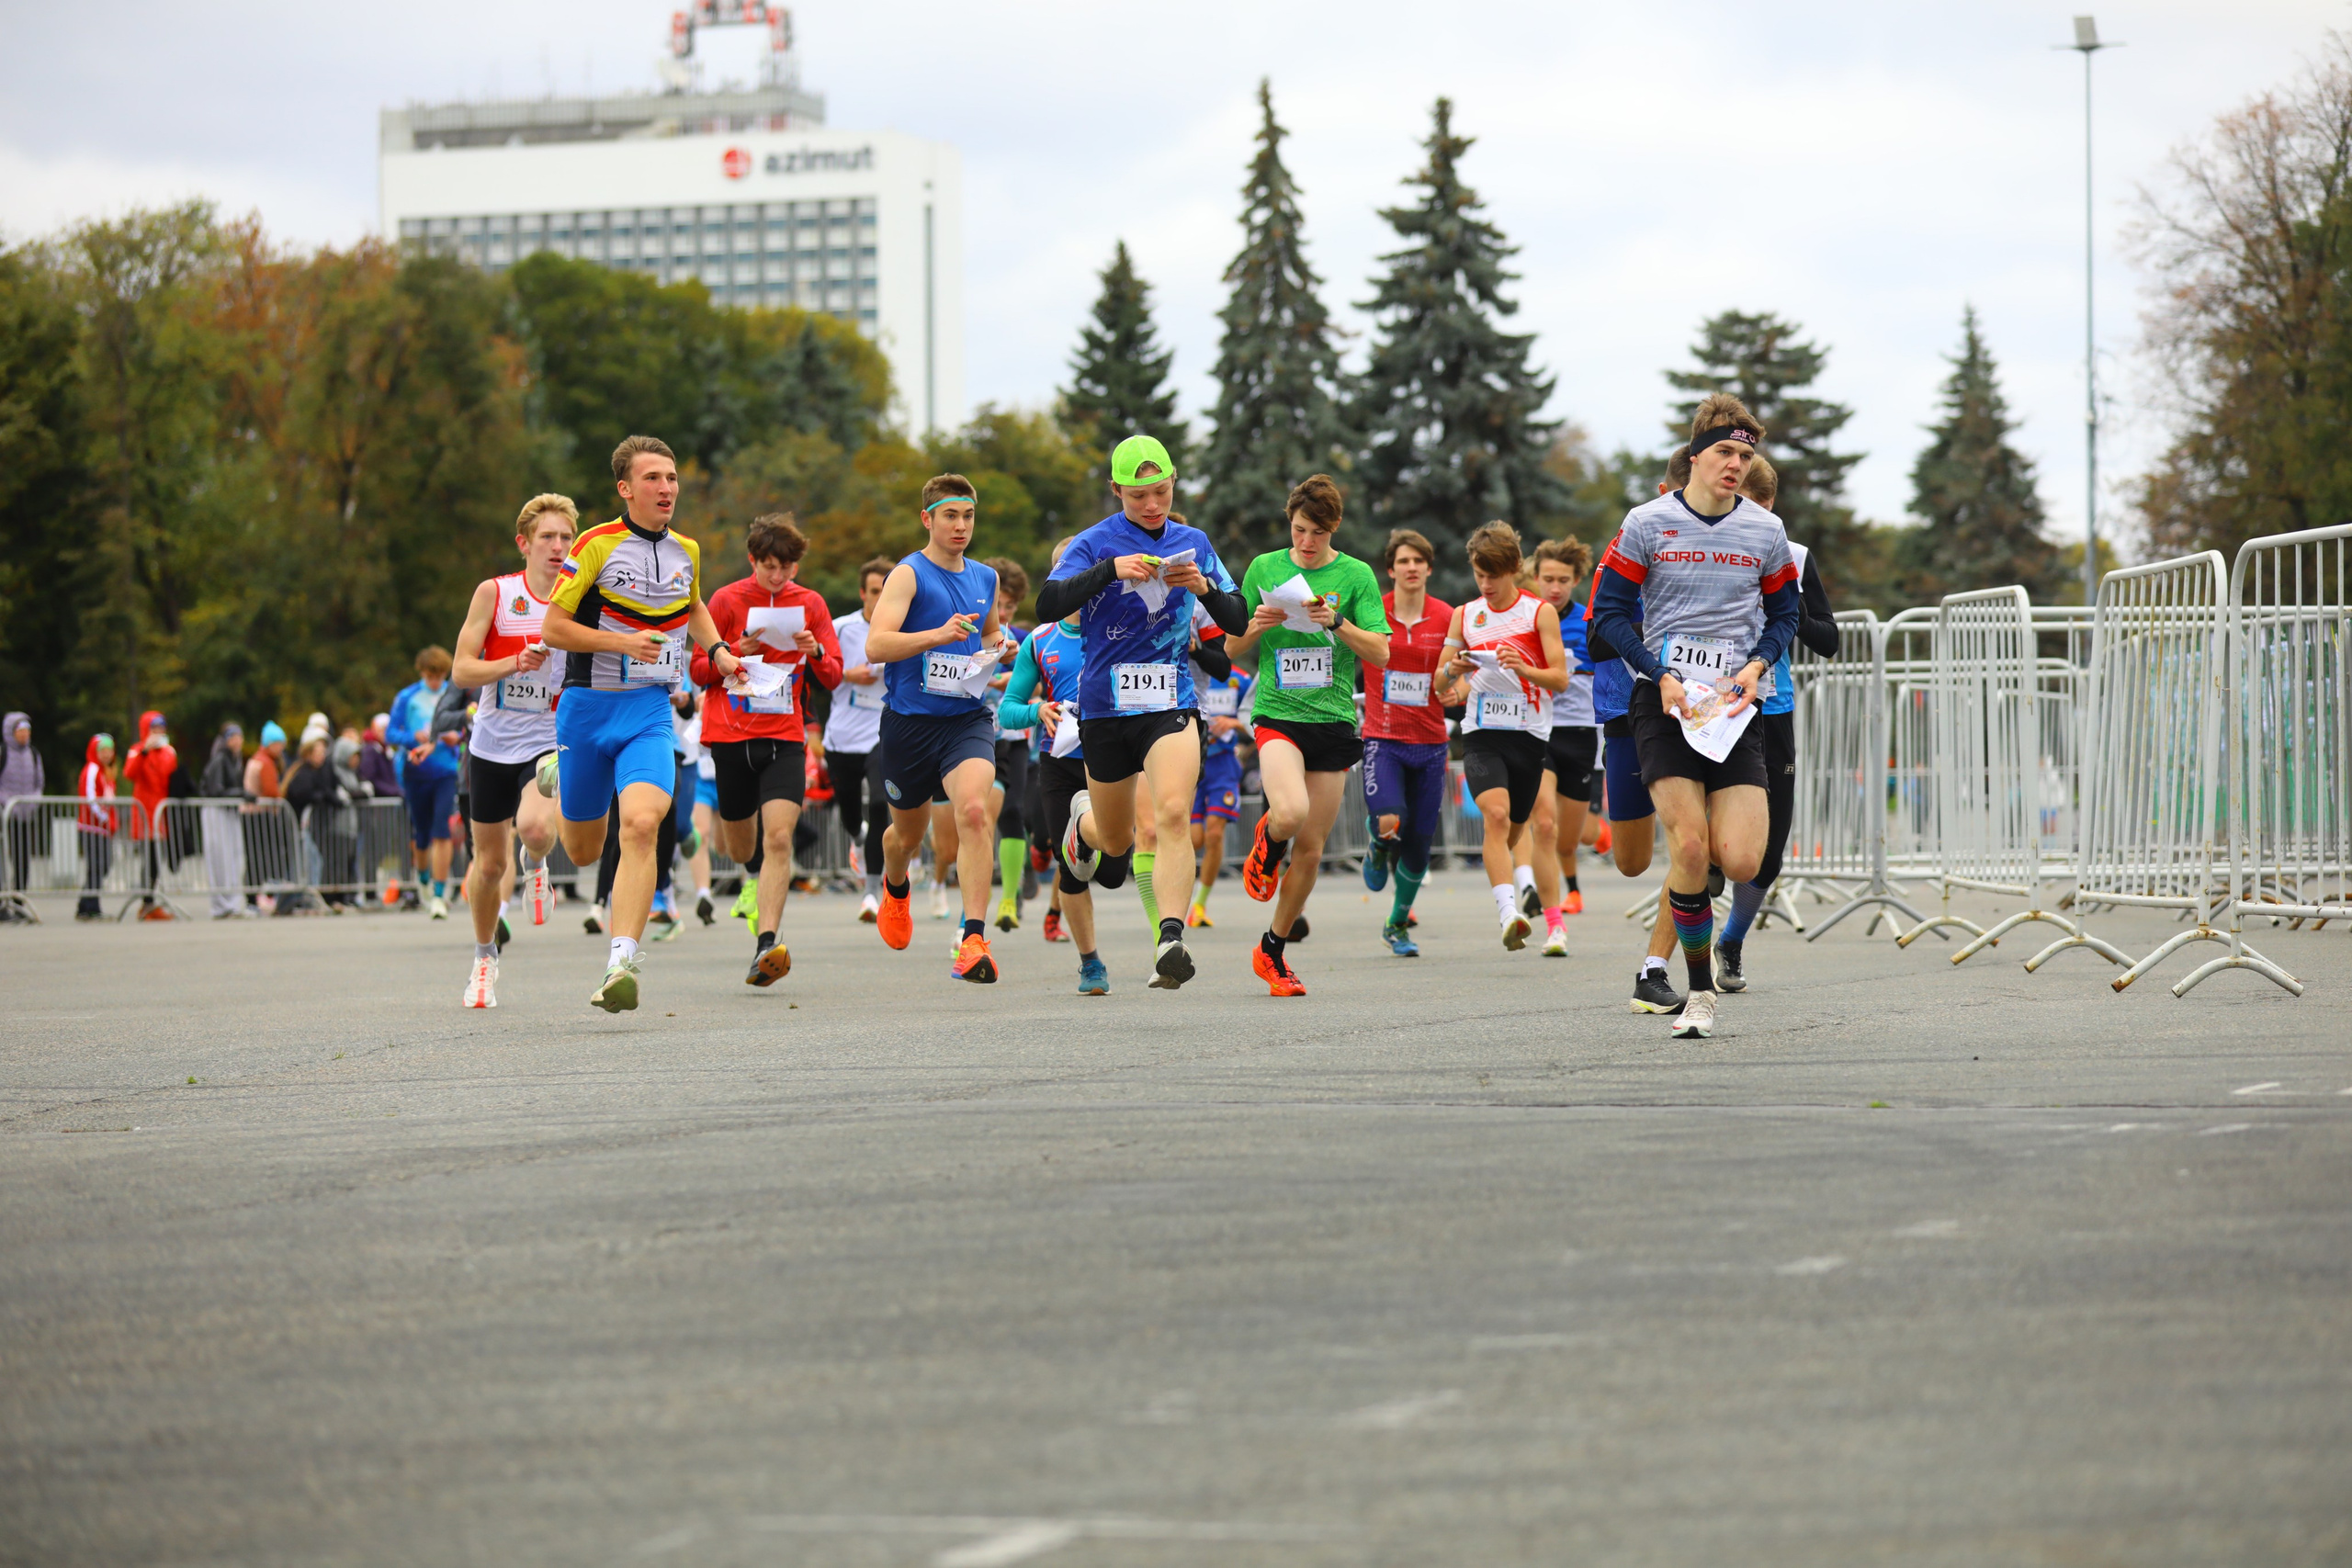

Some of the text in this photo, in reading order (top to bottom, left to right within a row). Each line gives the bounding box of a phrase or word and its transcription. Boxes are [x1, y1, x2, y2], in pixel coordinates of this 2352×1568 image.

[765, 144, 873, 173] azimut
[1653, 551, 1761, 569] NORD WEST
[1283, 658, 1322, 671] 207.1
[1672, 646, 1722, 669] 210.1
[1121, 674, 1165, 690] 219.1
[1391, 680, 1422, 691] 206.1
[507, 684, 546, 698] 229.1
[1485, 703, 1518, 716] 209.1
